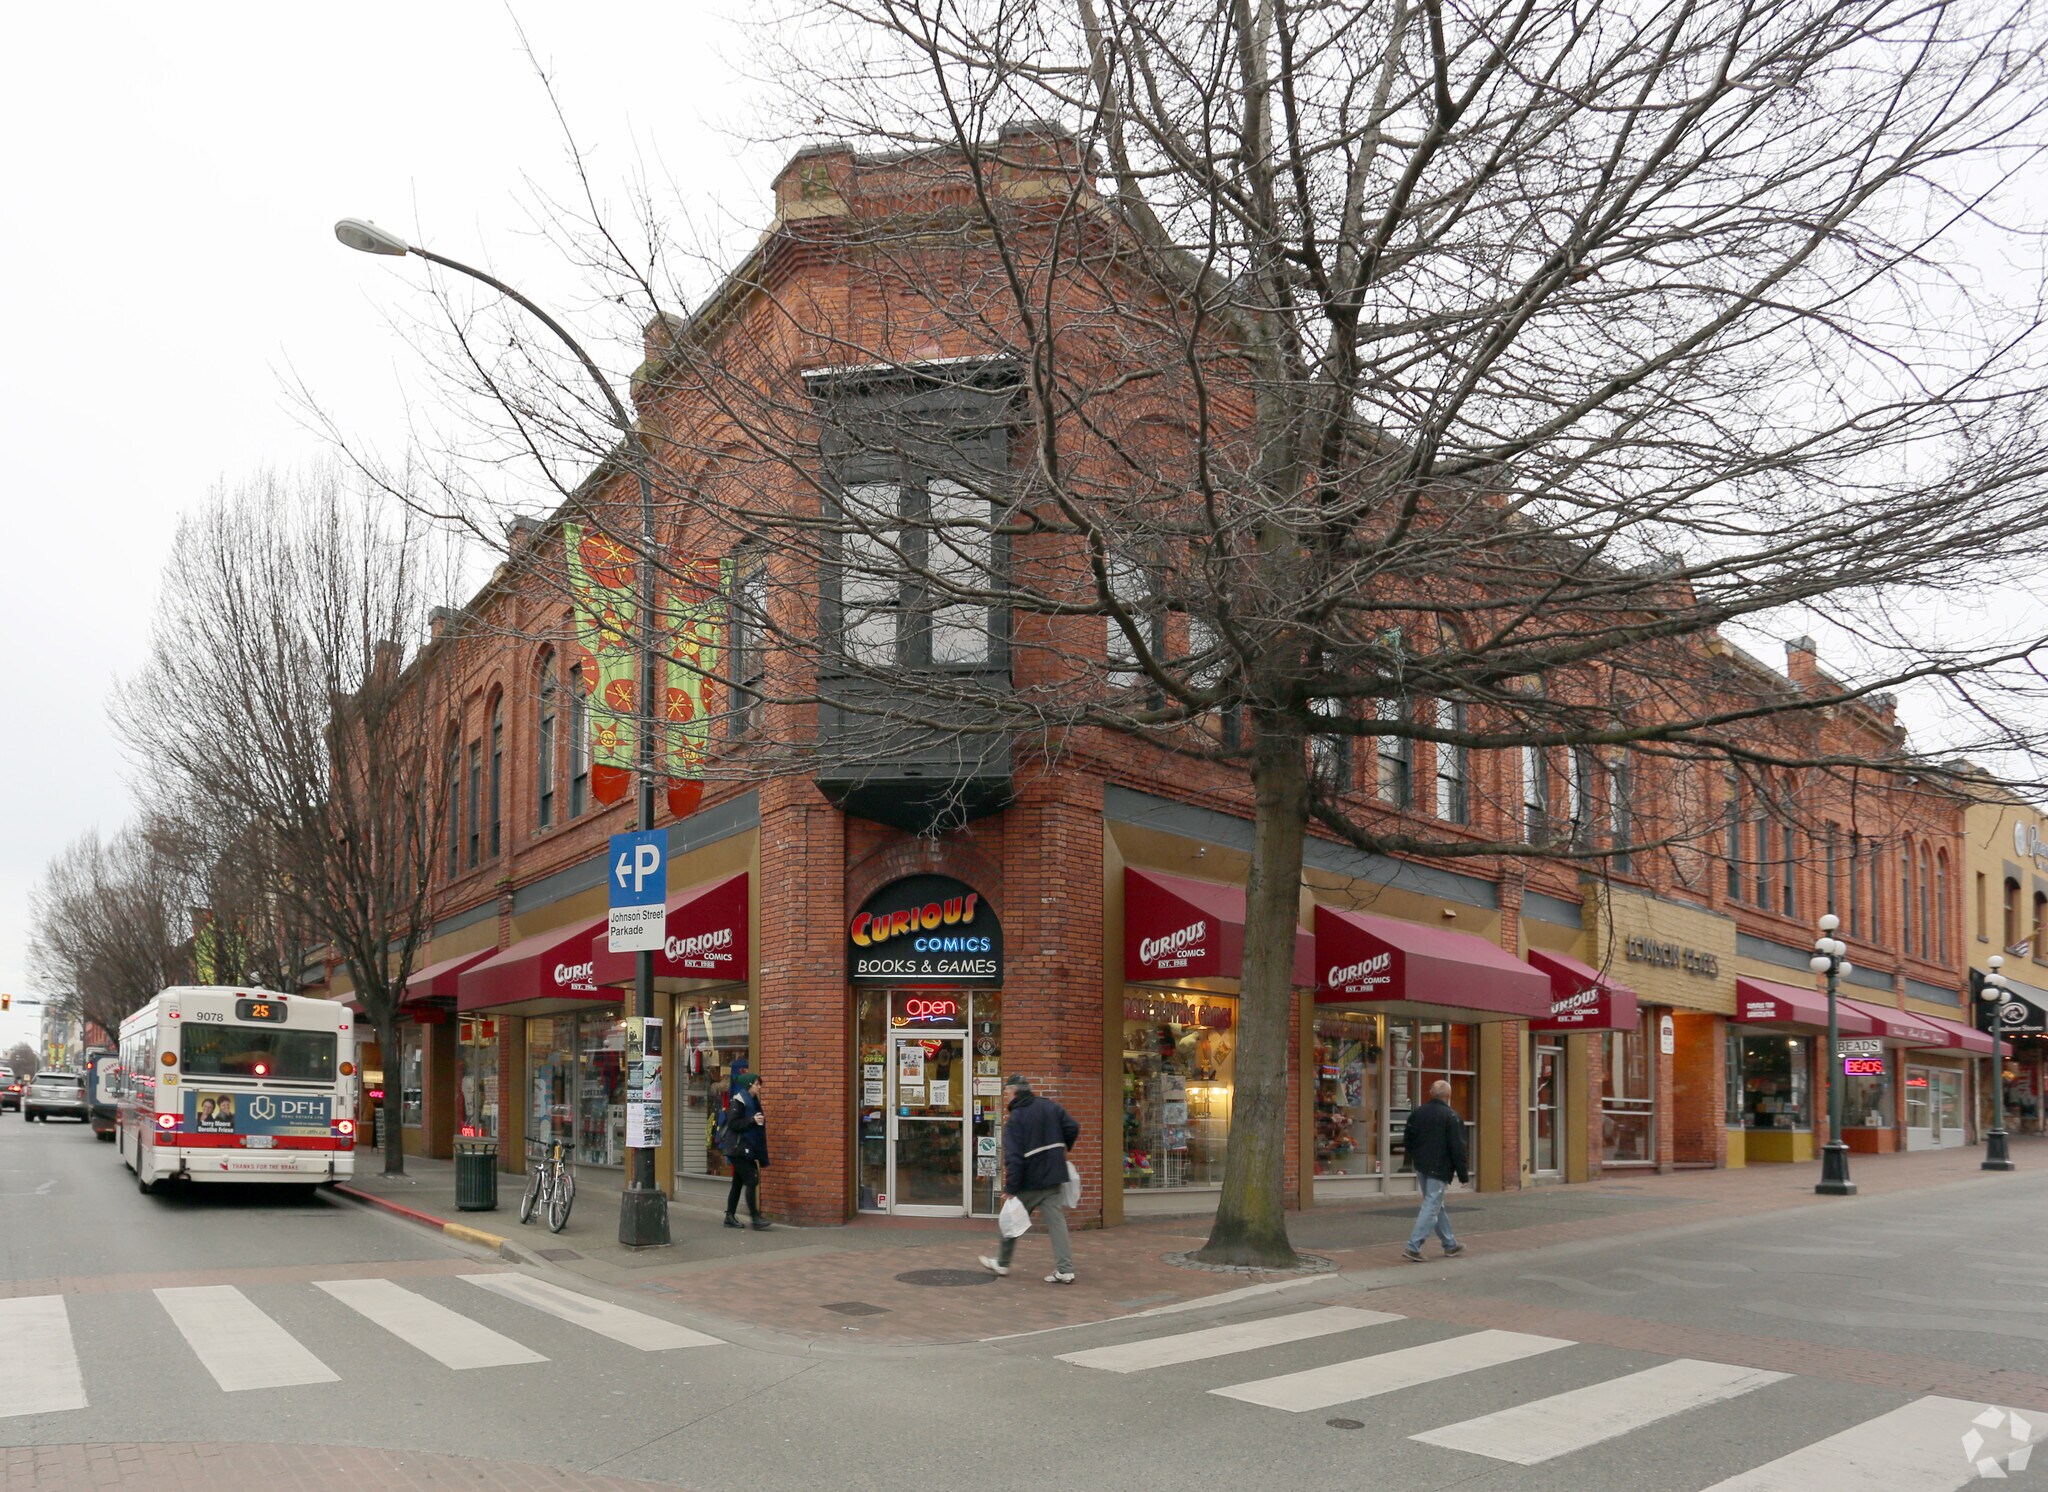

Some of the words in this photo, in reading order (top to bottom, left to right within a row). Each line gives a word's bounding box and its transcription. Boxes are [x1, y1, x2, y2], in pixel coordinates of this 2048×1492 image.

[635, 844, 660, 892] P
[611, 911, 641, 923] Johnson
[642, 909, 664, 920] Street
[851, 893, 978, 947] CURIOUS
[611, 925, 644, 936] Parkade
[664, 928, 732, 962] CURIOUS
[914, 937, 991, 952] COMICS
[1139, 920, 1206, 965] CURIOUS
[703, 952, 732, 961] COMICS
[1176, 948, 1206, 958] COMICS
[554, 961, 593, 985] CURIO
[857, 959, 917, 973] BOOKS
[920, 959, 932, 973] &
[937, 959, 997, 973] GAMES
[1328, 952, 1391, 989] CURIOUS
[1363, 976, 1391, 984] COMICS
[1551, 988, 1599, 1014] URIOUS
[196, 1012, 224, 1022] 9078
[252, 1004, 269, 1017] 25
[907, 999, 955, 1021] Open
[1837, 1041, 1878, 1051] BEADS
[1848, 1061, 1883, 1072] BEADS
[281, 1100, 324, 1115] DFH
